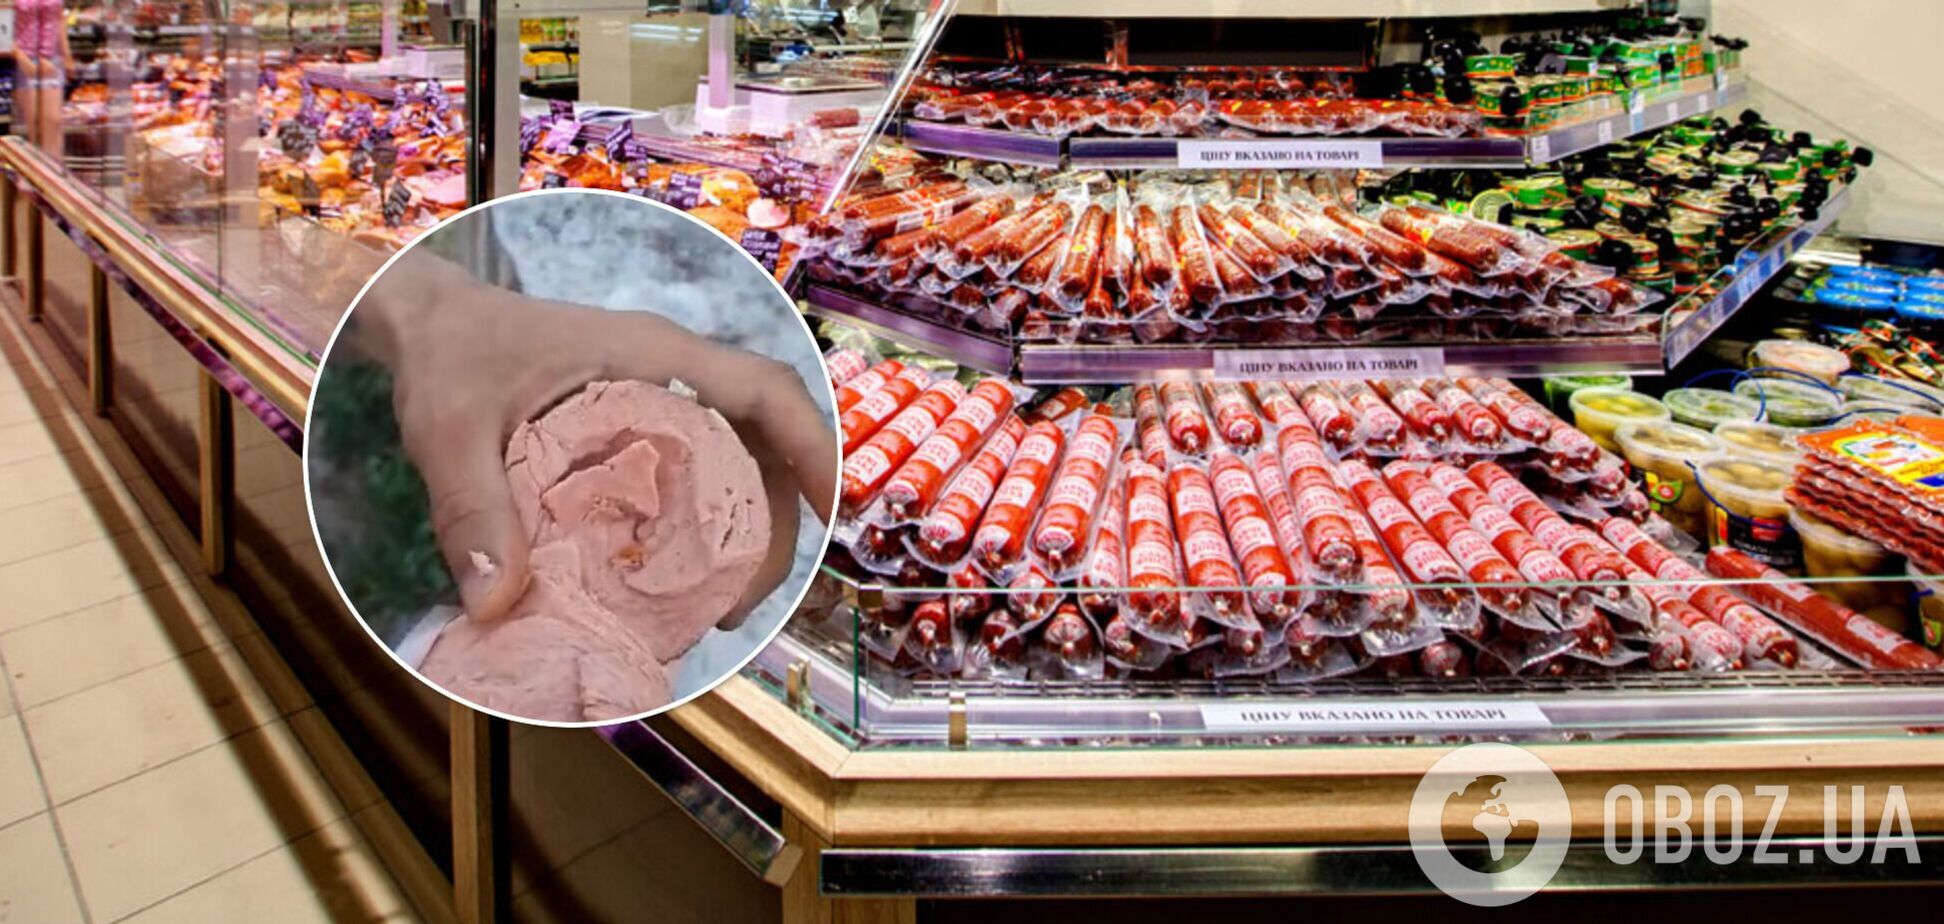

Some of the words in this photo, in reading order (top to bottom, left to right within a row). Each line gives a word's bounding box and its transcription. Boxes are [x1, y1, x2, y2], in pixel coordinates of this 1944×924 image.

[1200, 151, 1231, 163] ЦІНУ
[1235, 151, 1292, 161] ВКАЗАНО
[1295, 151, 1313, 160] НА
[1317, 151, 1360, 160] ТОВАРІ
[1240, 362, 1273, 374] ЦІНУ
[1278, 361, 1343, 373] ВКАЗАНО
[1346, 360, 1366, 371] НА
[1371, 359, 1418, 370] ТОВАРІ
[1241, 711, 1291, 724] ЦІНУ
[1300, 710, 1394, 722] ВКАЗАНО
[1400, 710, 1428, 720] НА
[1435, 709, 1506, 720] ТОВАРІ
